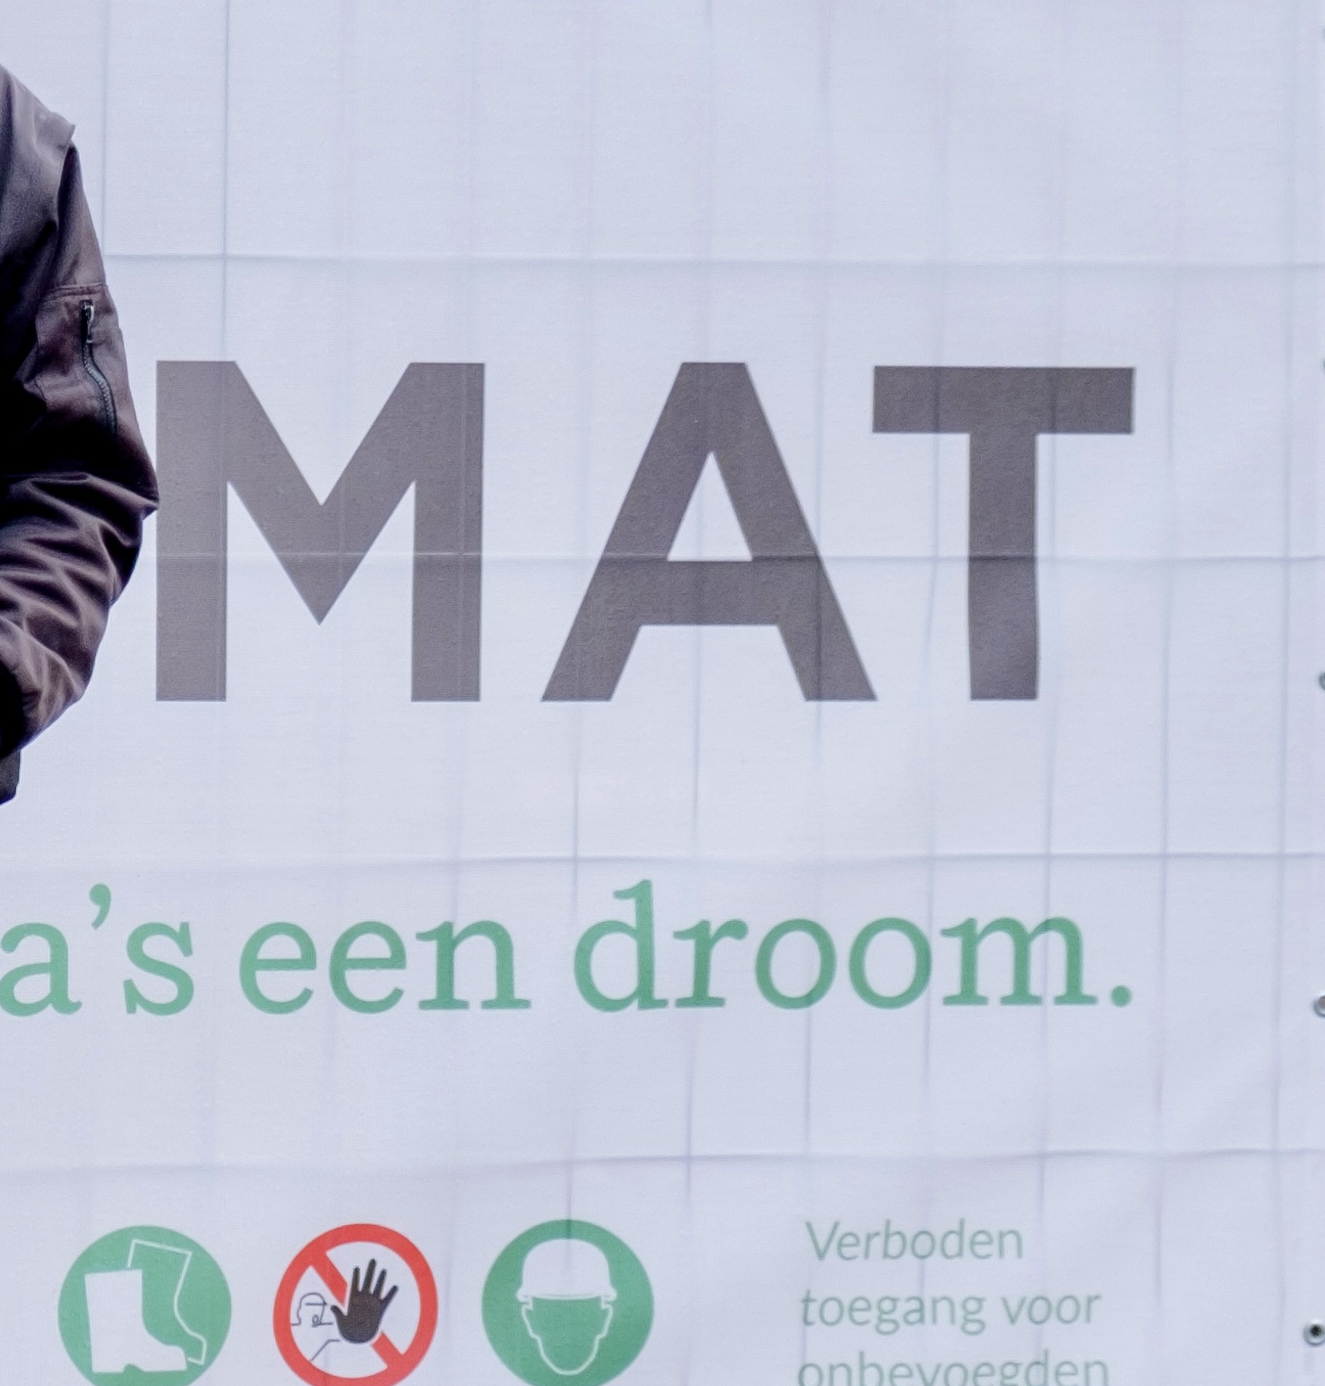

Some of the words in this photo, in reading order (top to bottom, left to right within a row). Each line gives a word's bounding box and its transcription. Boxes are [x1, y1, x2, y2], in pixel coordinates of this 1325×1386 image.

[155, 360, 1135, 702] MAT
[238, 919, 533, 1016] een
[572, 878, 1134, 1014] droom.
[804, 1217, 1025, 1263] Verboden
[799, 1288, 988, 1338] toegang
[1000, 1291, 1103, 1328] voor
